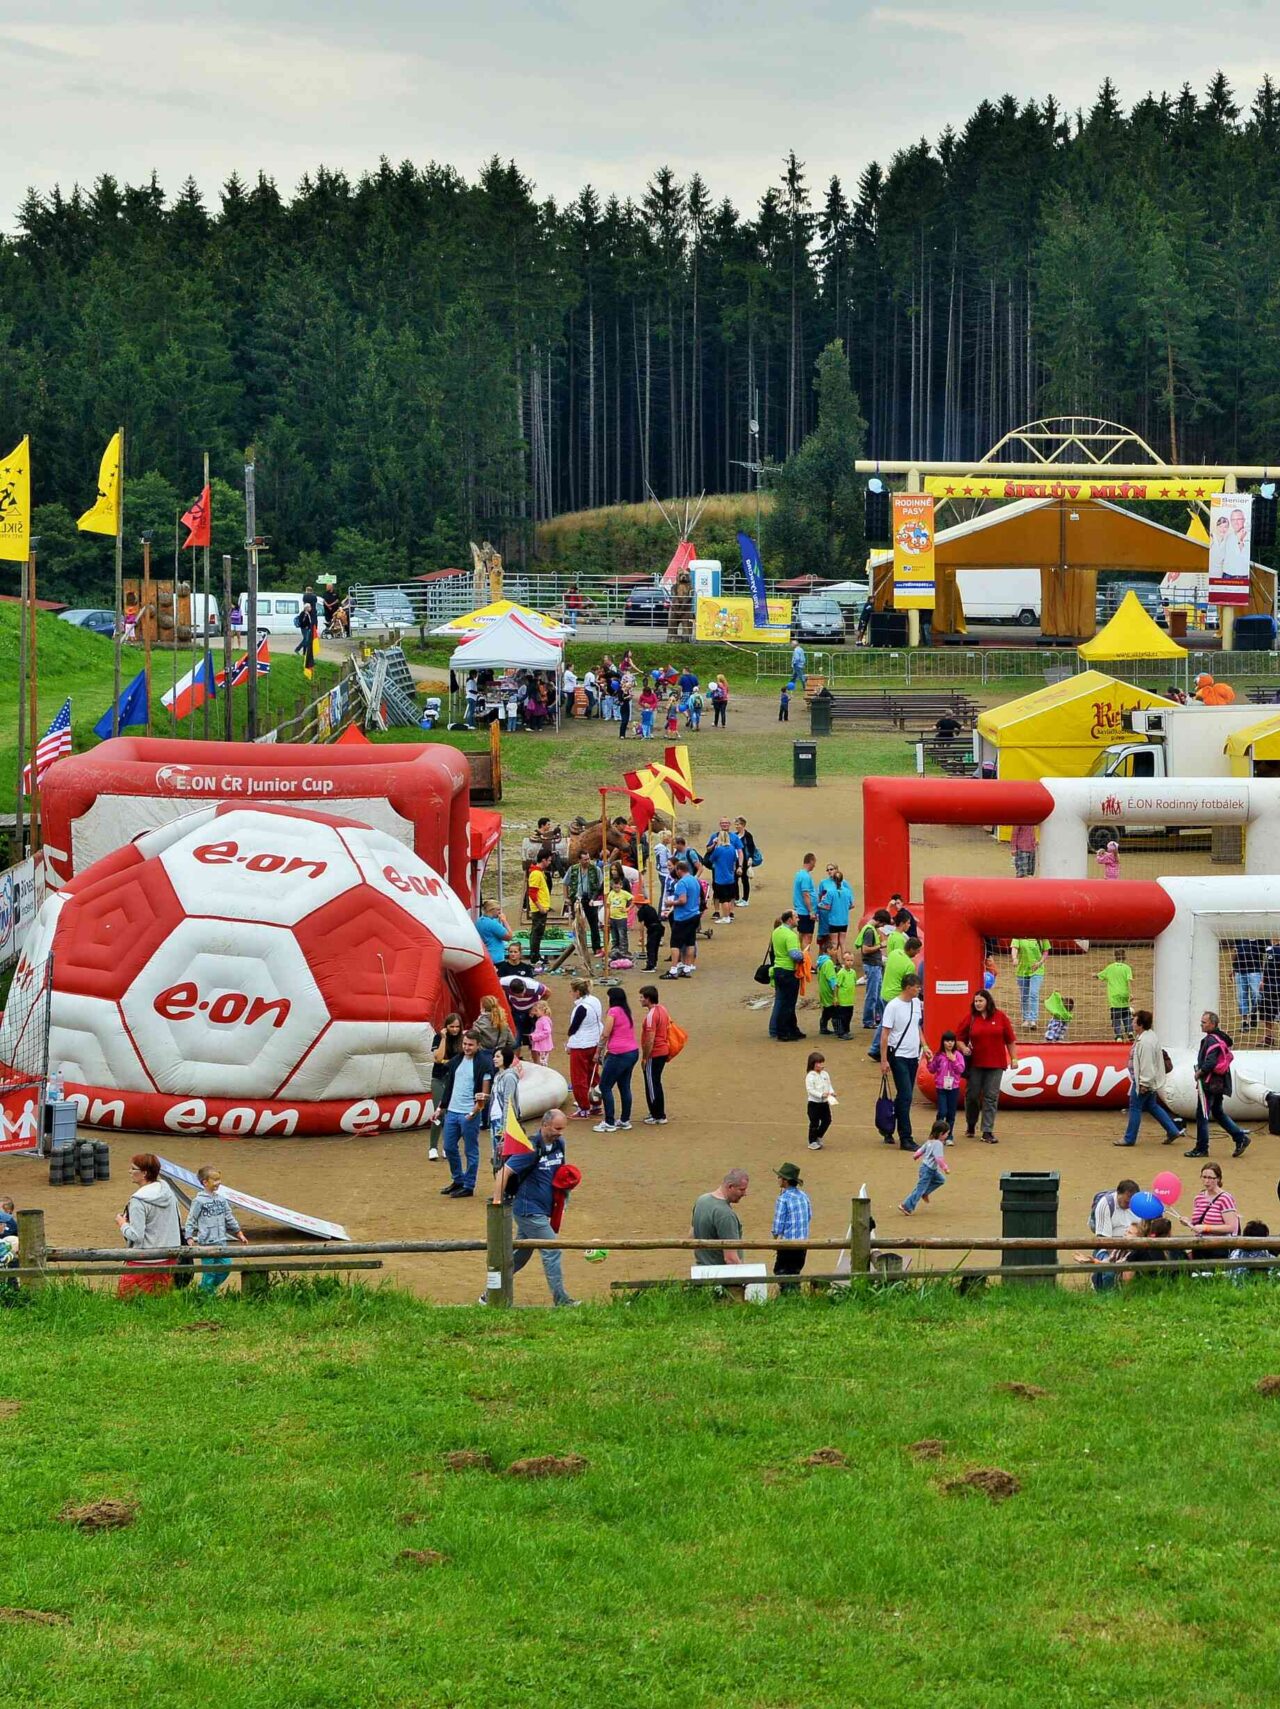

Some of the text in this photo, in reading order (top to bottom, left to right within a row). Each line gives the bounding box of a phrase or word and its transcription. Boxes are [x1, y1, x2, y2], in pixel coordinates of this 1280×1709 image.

[1003, 481, 1147, 499] ŠIKLŮV MLÝN
[895, 498, 932, 506] RODINNÉ
[176, 774, 333, 795] E.ON ČR Junior Cup
[1155, 798, 1199, 811] Rodinný
[1201, 798, 1245, 809] fotbálek
